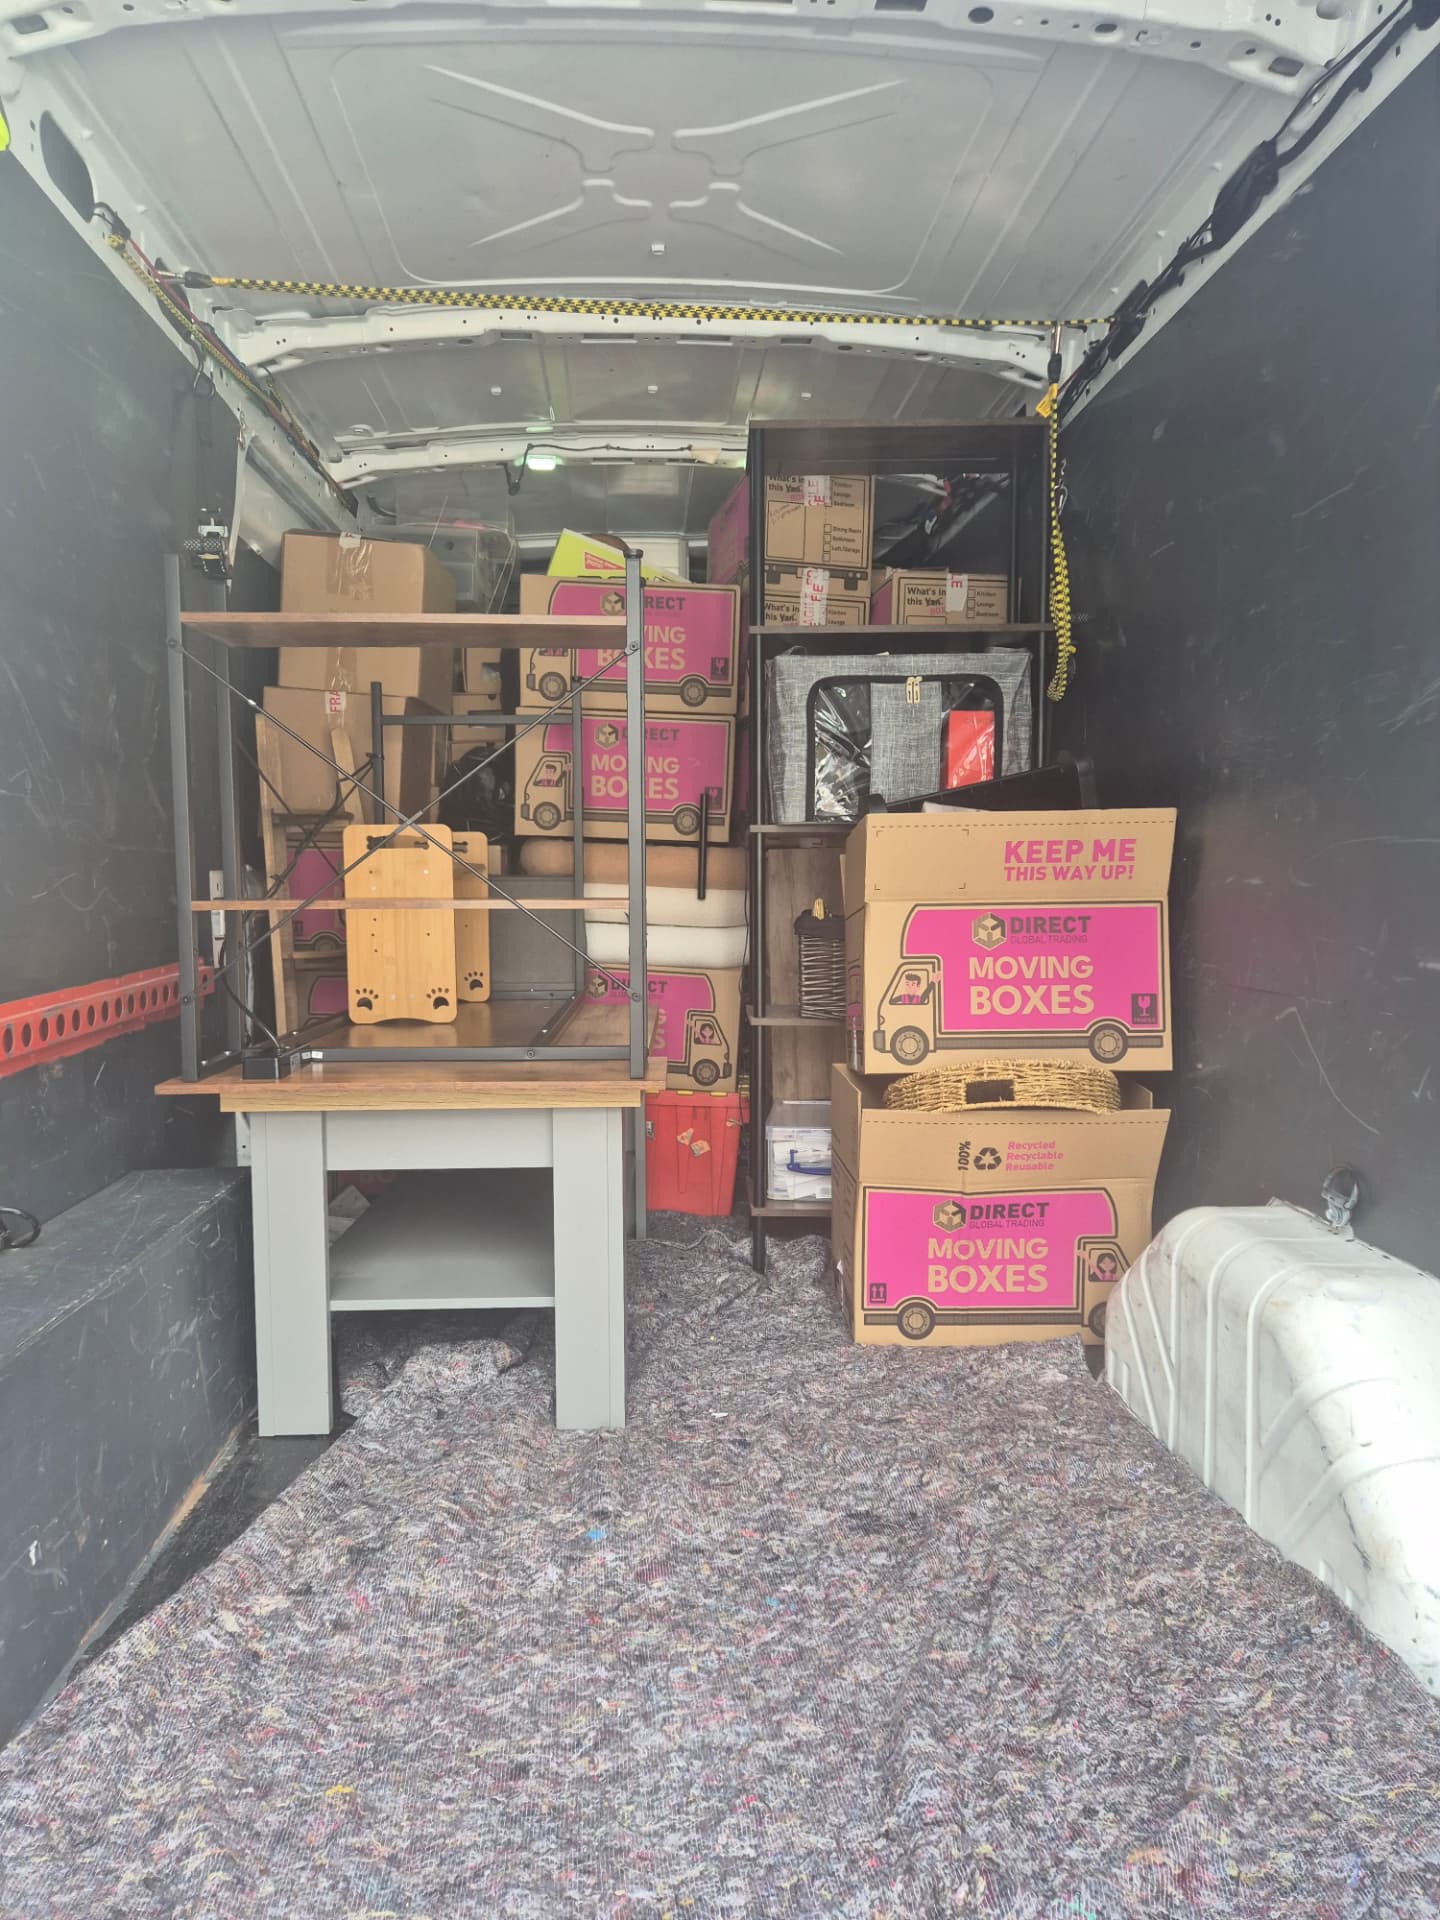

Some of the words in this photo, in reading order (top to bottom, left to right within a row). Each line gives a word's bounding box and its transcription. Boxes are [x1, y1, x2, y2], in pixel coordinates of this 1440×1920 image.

[907, 586, 936, 596] What's
[644, 596, 686, 611] RECT
[907, 596, 923, 606] this
[591, 754, 681, 774] MONG
[591, 775, 680, 801] BOES
[1004, 839, 1083, 865] KEEP
[1092, 838, 1137, 862] ME
[1004, 866, 1047, 882] THIS
[1052, 865, 1097, 881] WAY
[1100, 864, 1135, 880] UP!
[1010, 916, 1091, 934] DIRECT
[1010, 935, 1044, 944] GLOBAL
[1047, 935, 1088, 944] TRADING
[968, 955, 1093, 980] MOVING
[970, 984, 1094, 1016] BOXES
[1007, 1141, 1056, 1151] Recycled
[957, 1140, 972, 1171] 100%
[1006, 1151, 1064, 1162] Recyclable
[1005, 1162, 1055, 1172] Reusable
[970, 1202, 1050, 1220] DIRECT
[969, 1221, 1002, 1230] GLOBAL
[1005, 1219, 1045, 1228] TRADING
[927, 1237, 1049, 1261] MOVING
[927, 1264, 1049, 1294] BOXES
